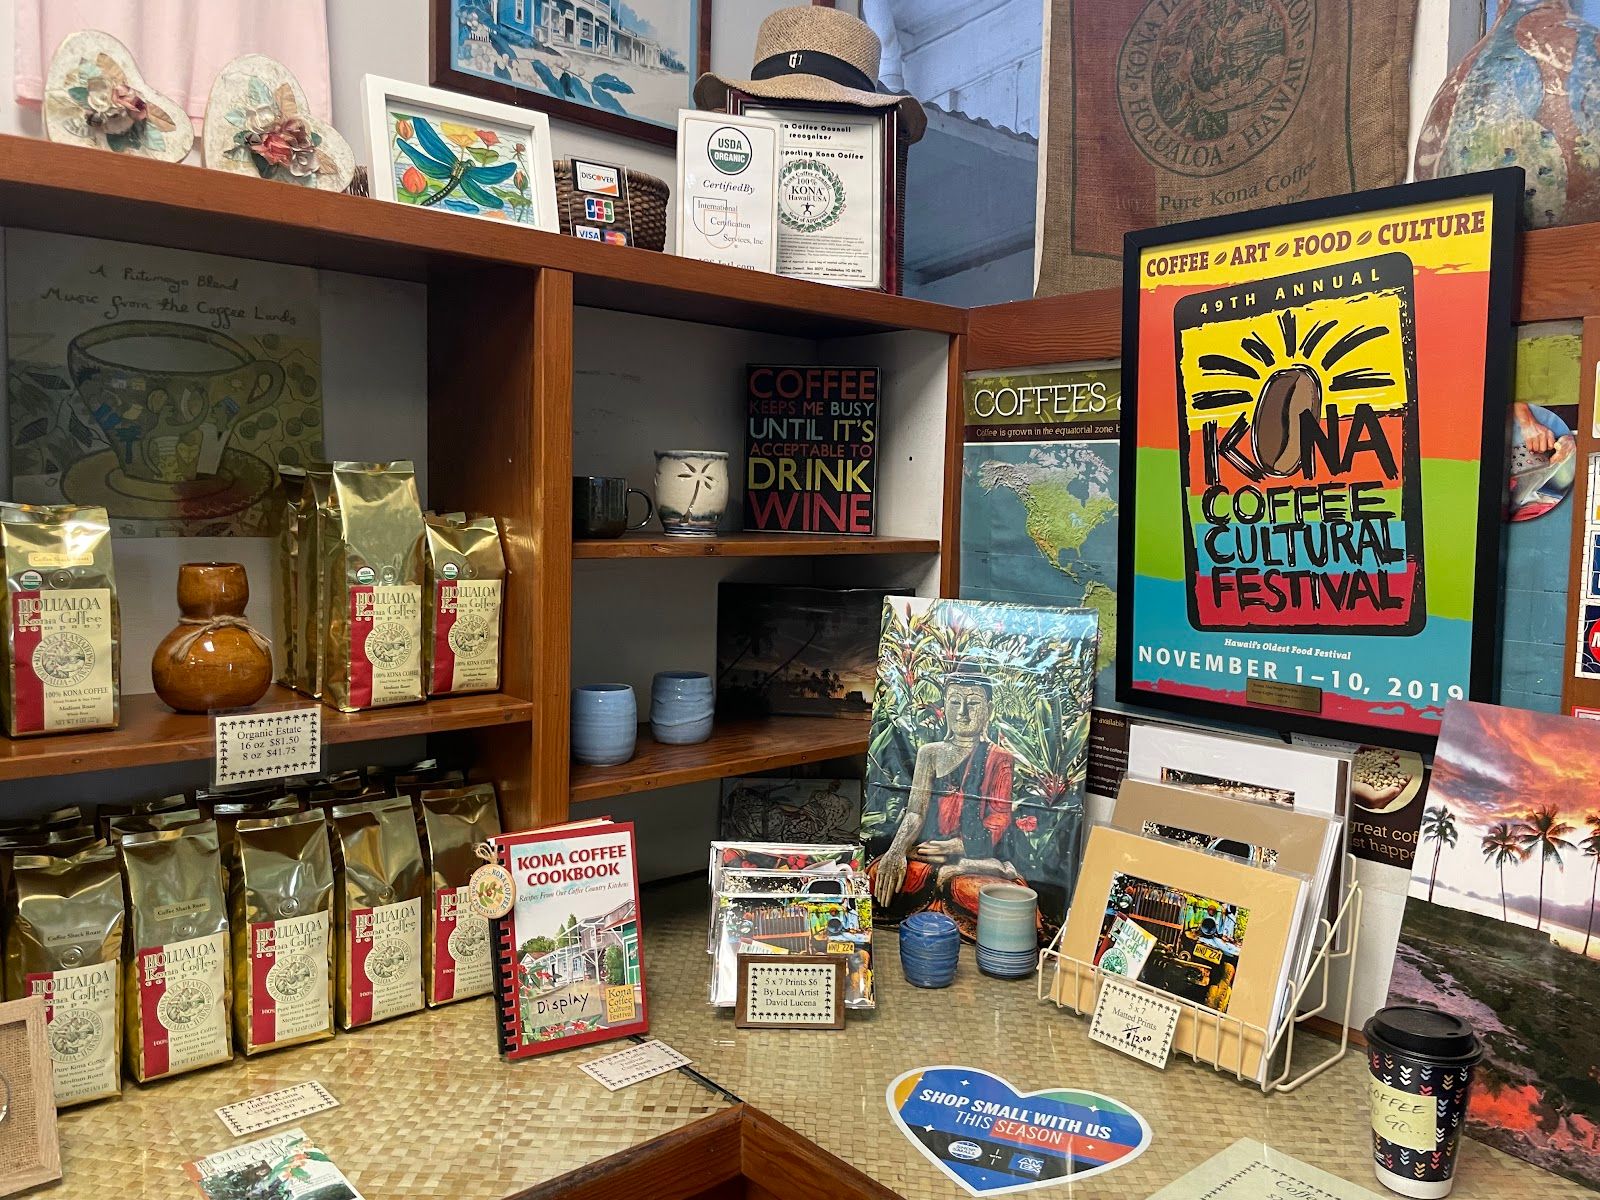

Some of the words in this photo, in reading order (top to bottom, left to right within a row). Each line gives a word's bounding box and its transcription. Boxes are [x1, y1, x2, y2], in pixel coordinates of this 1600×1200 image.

[1126, 20, 1162, 81] KONA
[718, 138, 742, 150] USDA
[714, 152, 745, 163] ORGANIC
[581, 172, 614, 184] DISCOVER
[1209, 182, 1259, 206] Kona
[1265, 157, 1317, 193] Coffee
[791, 186, 823, 195] KONA
[698, 200, 737, 211] International
[710, 217, 750, 229] Certification
[579, 230, 599, 240] VISA
[1146, 250, 1209, 278] COFFEE
[1230, 242, 1271, 267] ART
[1292, 230, 1353, 257] FOOD
[1377, 210, 1485, 247] CULTURE
[197, 275, 239, 292] Blend
[1199, 292, 1257, 316] 49TH
[1275, 267, 1383, 301] ANNUAL
[160, 297, 189, 314] the
[750, 368, 875, 400] COFFEE
[750, 400, 796, 415] KEEPS
[803, 402, 824, 416] ME
[830, 402, 874, 416] BUSY
[974, 382, 1107, 418] COFFEES
[750, 417, 823, 441] UNTIL
[833, 419, 874, 442] IT'S
[977, 428, 997, 437] Coffee
[1000, 427, 1005, 436] is
[1007, 427, 1032, 438] grown
[1034, 427, 1041, 436] in
[1043, 426, 1053, 435] the
[1055, 425, 1093, 438] equatorial
[1095, 426, 1114, 434] zone
[1202, 398, 1400, 484] KONA
[750, 443, 844, 458] ACCEPTABLE
[850, 444, 872, 458] TO
[748, 457, 871, 492] DRINK
[1202, 481, 1396, 525] COFFEE
[749, 491, 871, 533] WINE
[1203, 517, 1406, 567] CULTURAL
[442, 586, 496, 598] HOLUALOA
[1212, 566, 1405, 612] FESTIVAL
[19, 597, 101, 612] HOLUALOA
[356, 592, 416, 605] HOLUALOA
[441, 598, 468, 609] Kona
[469, 598, 496, 609] Coffee
[19, 612, 57, 626] Kona
[59, 611, 102, 625] Coffee
[356, 605, 385, 617] Kona
[388, 605, 416, 617] Coffee
[1223, 638, 1261, 649] Hawaii's
[1262, 642, 1290, 655] Oldest
[1291, 645, 1313, 656] Food
[1314, 647, 1352, 660] Festival
[1138, 645, 1278, 681] NOVEMBER
[1388, 677, 1464, 701] 2019
[63, 689, 82, 697] KONA
[83, 687, 108, 695] COFFEE
[237, 729, 273, 740] Organic
[276, 726, 302, 735] Estate
[241, 742, 251, 750] 16
[270, 736, 299, 747] $81.50
[267, 747, 296, 757] $41.75
[1392, 830, 1419, 844] cof
[517, 852, 564, 871] KONA
[569, 844, 626, 863] COFFEE
[527, 862, 620, 886] COOKBOOK
[492, 869, 506, 883] KONA
[501, 883, 510, 910] COFFEE
[519, 893, 539, 902] Recipes
[540, 891, 554, 900] From
[555, 889, 567, 897] Our
[568, 886, 584, 895] Coffee
[585, 884, 606, 894] Country
[607, 881, 629, 890] Kitchens
[157, 908, 175, 916] Coffee
[356, 905, 416, 928] HOLUALOA
[256, 919, 322, 941] HOLUALOA
[356, 927, 384, 938] Kona
[387, 920, 416, 932] Coffee
[257, 941, 288, 953] Kona
[290, 934, 322, 947] Coffee
[145, 942, 216, 968] HOLUALOA
[145, 967, 179, 982] Kona
[181, 956, 218, 973] Coffee
[32, 970, 110, 995] HOLUALOA
[785, 978, 807, 986] Prints
[809, 978, 817, 986] $6
[71, 987, 110, 1002] Coffee
[608, 989, 632, 998] Kona
[763, 988, 774, 997] By
[776, 988, 797, 996] Local
[798, 988, 819, 996] Artist
[608, 997, 632, 1006] Coffee
[609, 1005, 632, 1013] Cultural
[765, 998, 788, 1007] David
[790, 999, 816, 1007] Lucena
[609, 1012, 633, 1021] Festival
[1113, 1006, 1136, 1022] Matted
[1137, 1017, 1156, 1030] Prints
[919, 1089, 970, 1108] SHOP
[971, 1099, 1029, 1123] SMALL
[1034, 1112, 1080, 1133] WITH
[1085, 1123, 1112, 1140] US
[955, 1110, 993, 1130] THIS
[995, 1119, 1063, 1145] SEASON
[953, 1147, 976, 1155] SMALL
